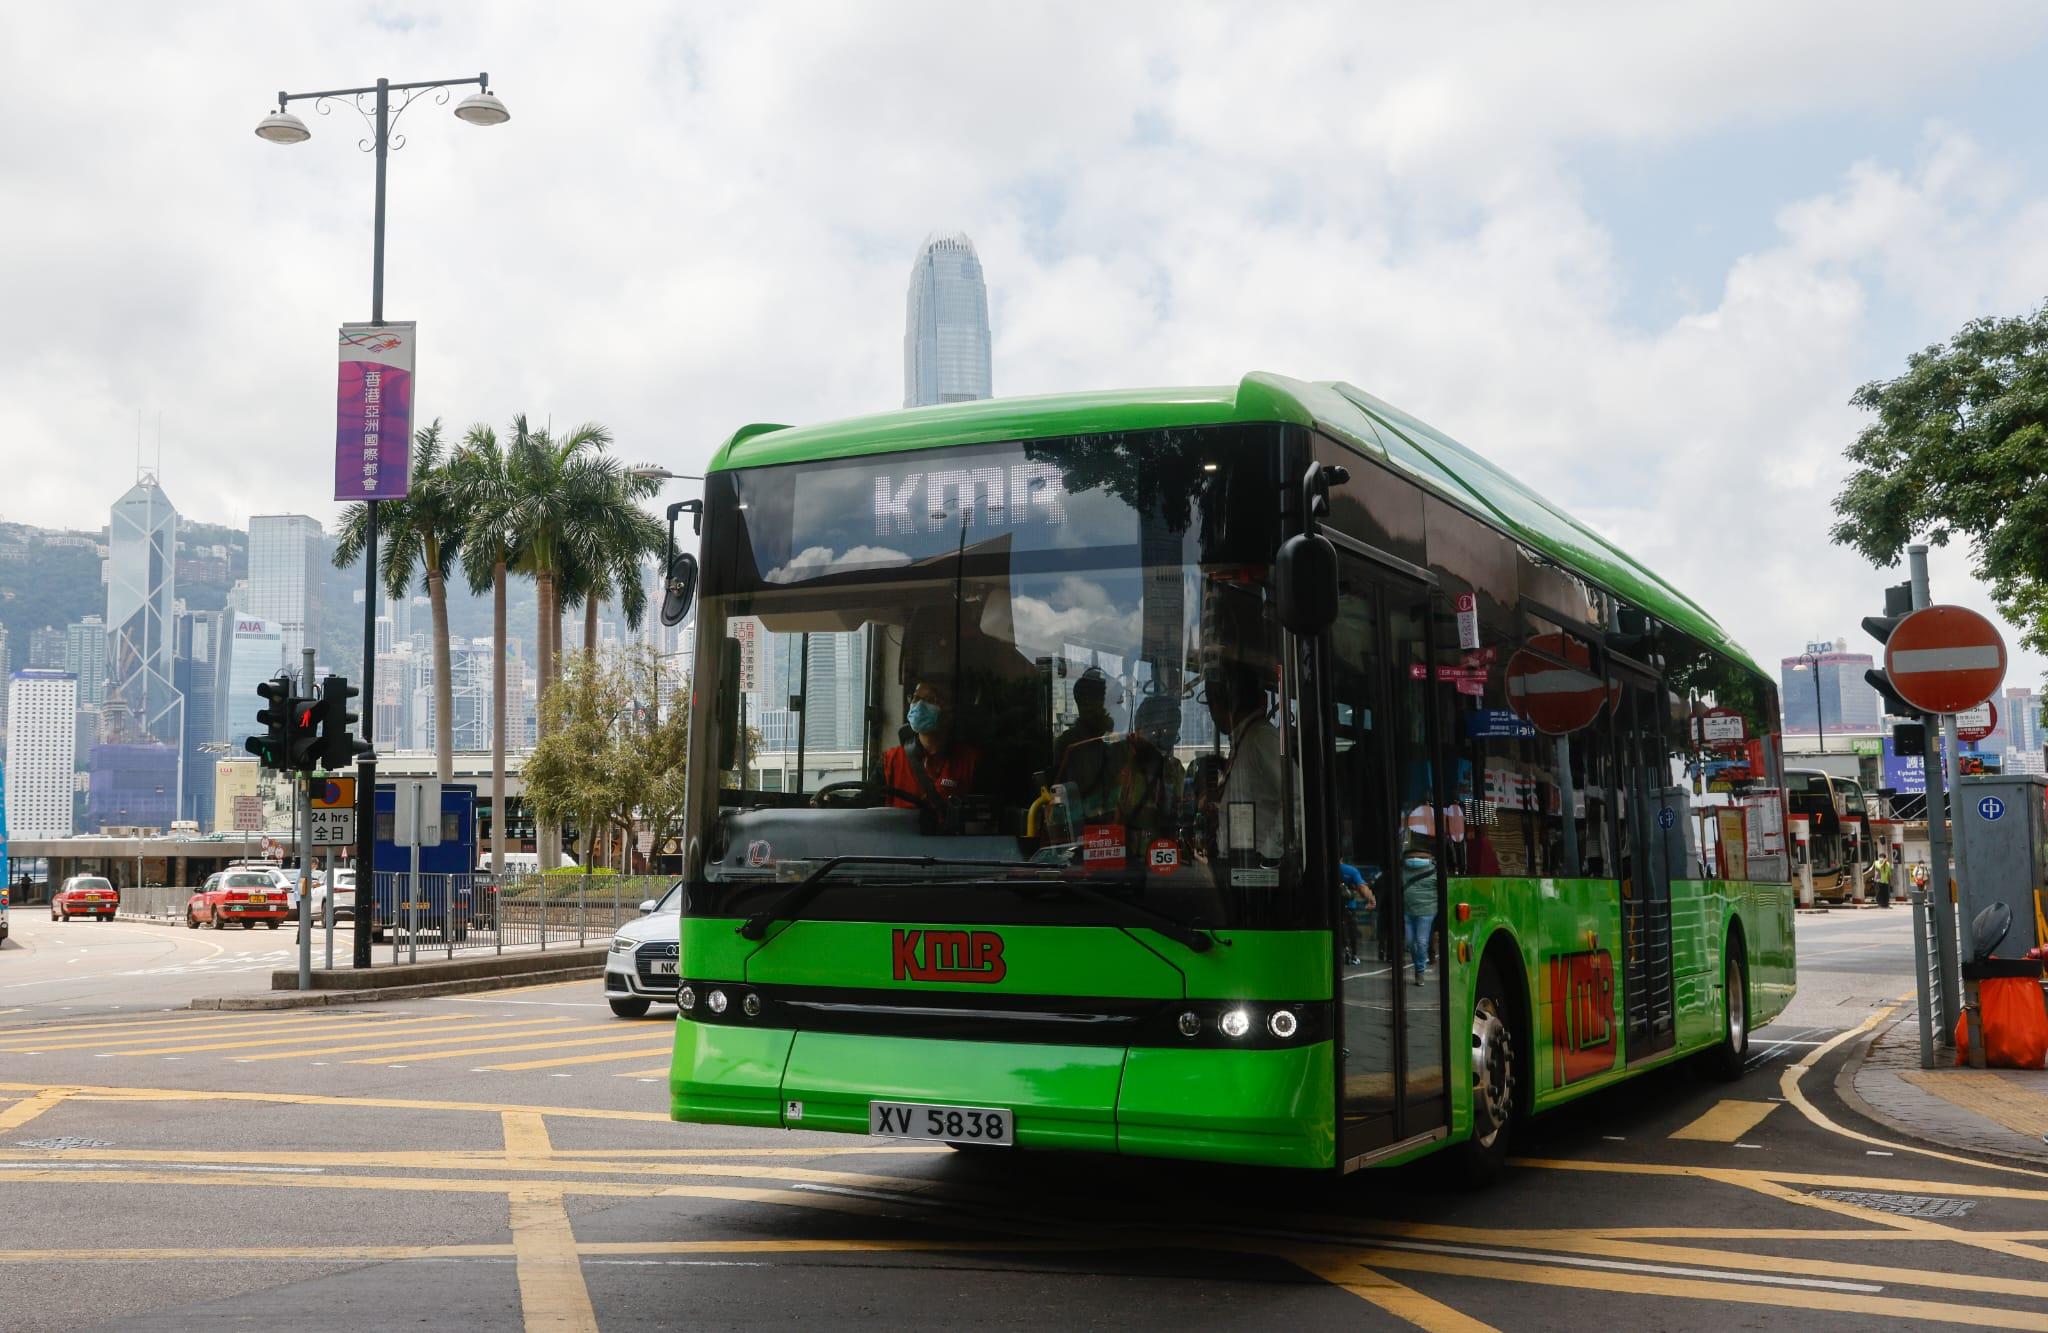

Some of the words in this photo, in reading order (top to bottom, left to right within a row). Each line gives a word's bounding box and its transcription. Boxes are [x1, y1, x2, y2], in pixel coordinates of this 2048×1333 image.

[362, 371, 382, 491] 香港亞洲國際都會
[239, 621, 262, 632] AIA
[311, 812, 327, 823] 24
[331, 812, 349, 823] hrs
[1815, 812, 1823, 825] 7
[314, 826, 344, 841] 全日
[891, 928, 1007, 984] KMB
[661, 962, 677, 974] NK
[1551, 949, 1617, 1090] KMB
[877, 1105, 913, 1134] XV
[927, 1109, 1004, 1140] 5838
